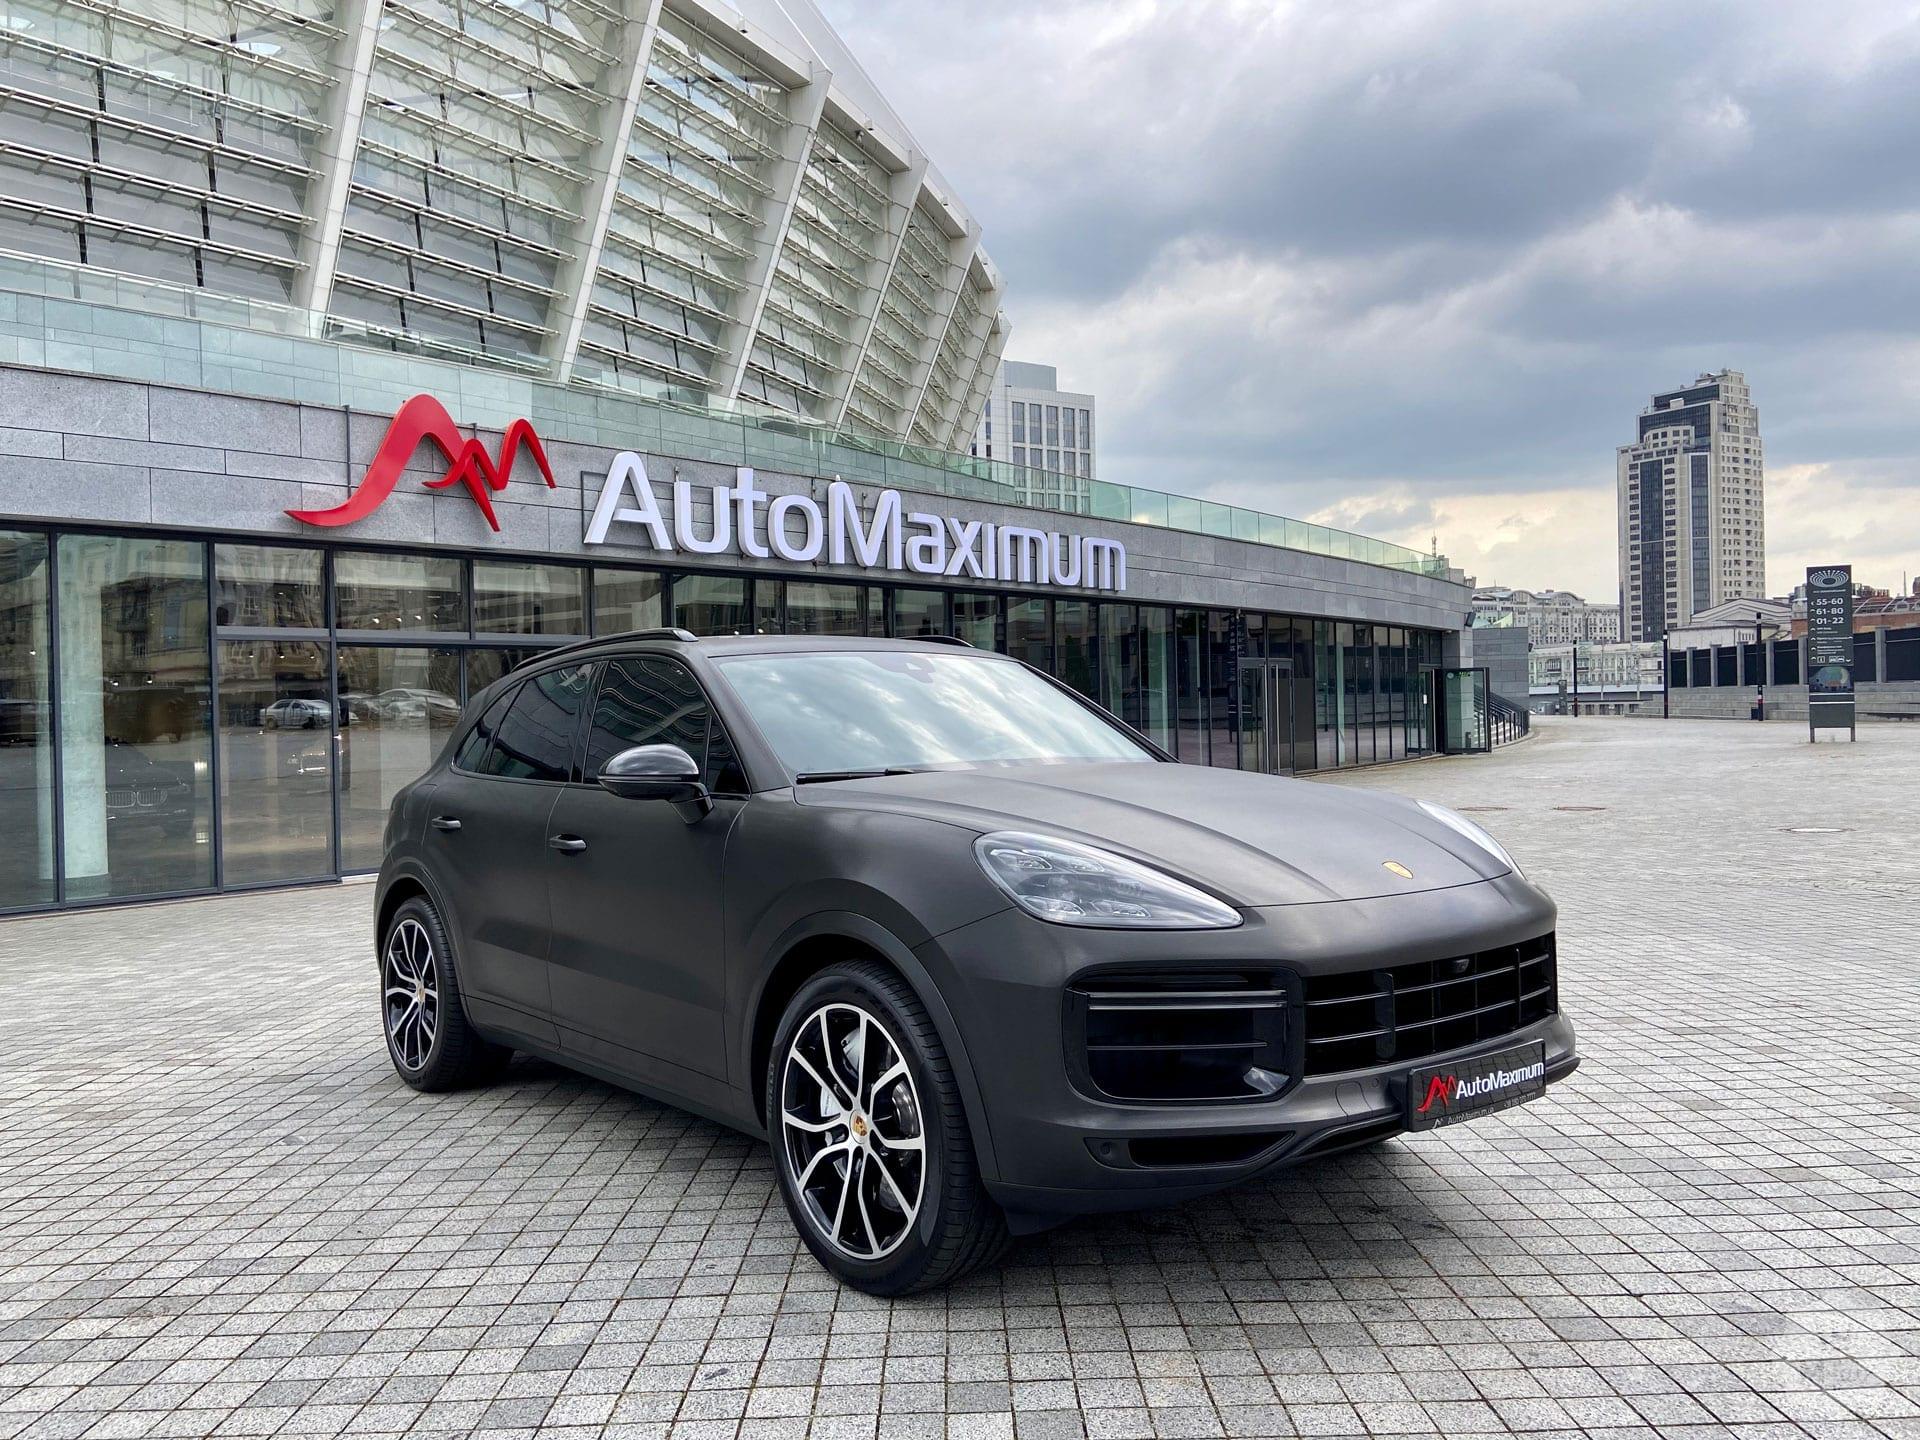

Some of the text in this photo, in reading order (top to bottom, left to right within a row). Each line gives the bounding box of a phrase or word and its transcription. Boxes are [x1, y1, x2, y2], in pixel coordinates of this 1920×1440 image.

[583, 451, 1127, 591] AutoMaximum
[1816, 607, 1844, 615] 61-80
[1816, 617, 1844, 625] 01-22
[1455, 1062, 1544, 1100] AutoMaximum
